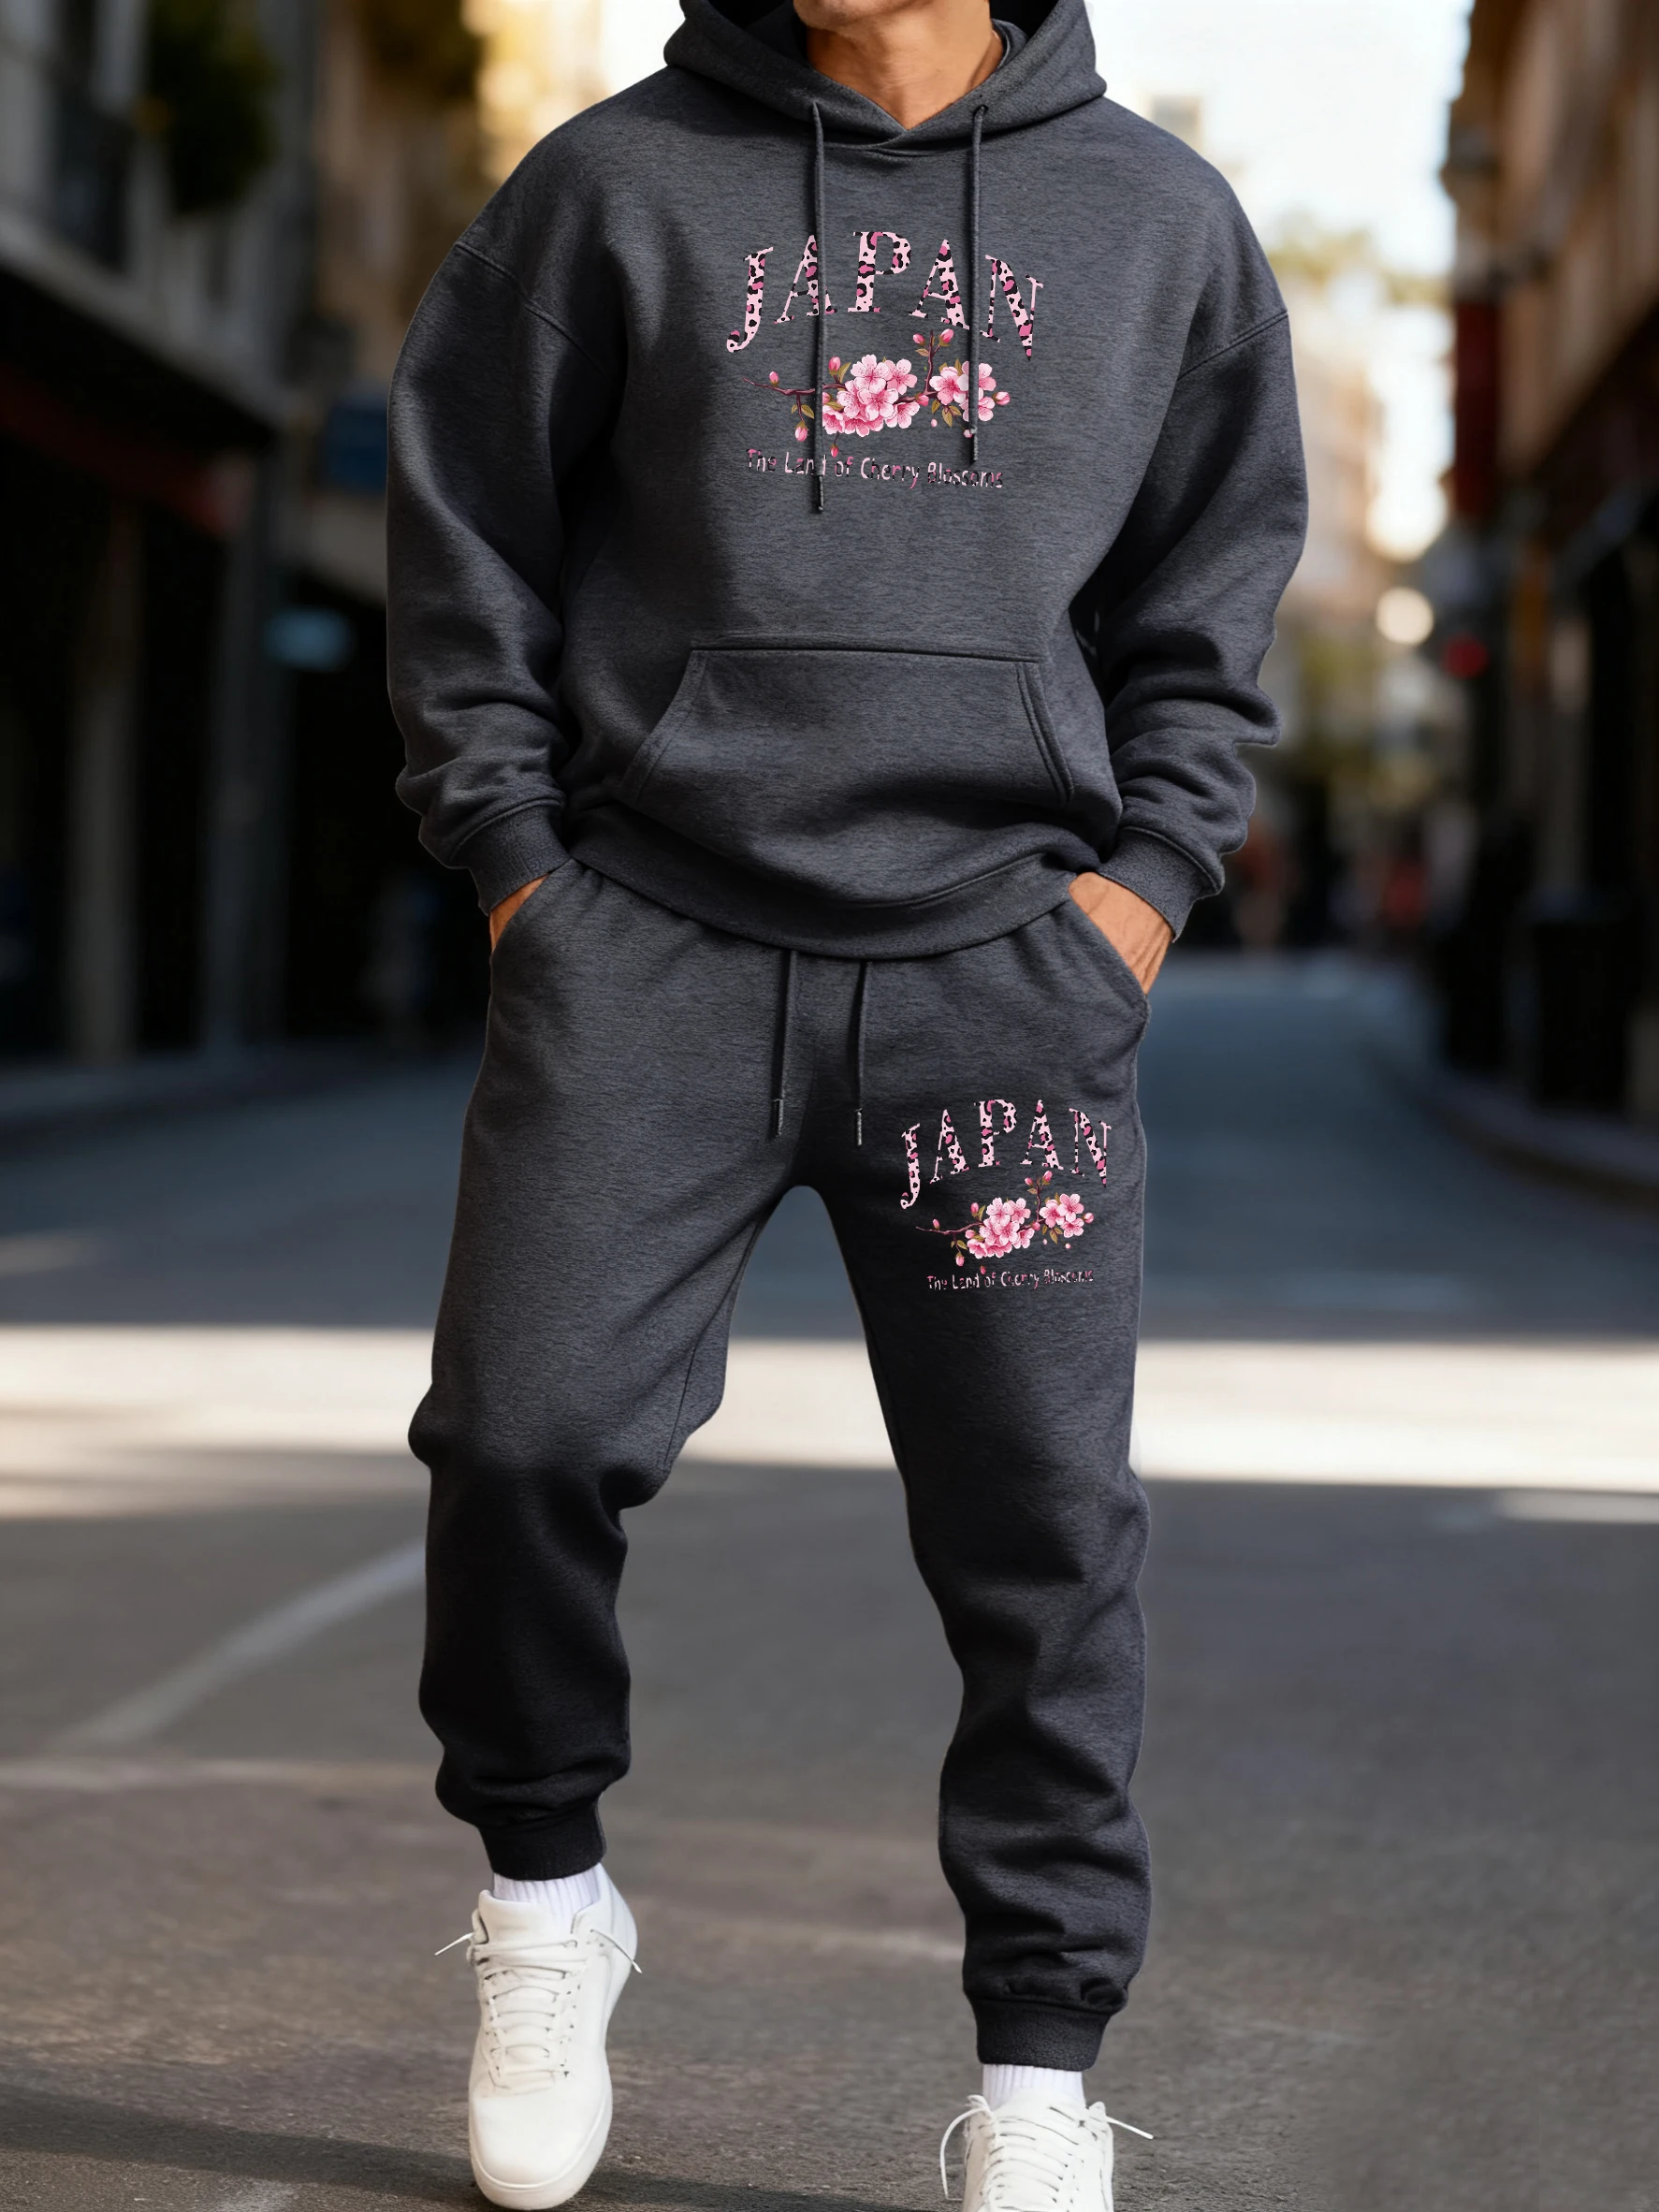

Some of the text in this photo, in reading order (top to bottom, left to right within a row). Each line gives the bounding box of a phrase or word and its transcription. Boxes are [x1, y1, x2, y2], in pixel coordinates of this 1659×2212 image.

[726, 231, 1044, 362] JAPAN
[746, 448, 778, 473] The
[834, 456, 854, 477] of
[860, 457, 921, 489] Cherry
[927, 461, 1004, 488] Blossoms
[900, 1099, 1113, 1210] JAPAN
[952, 1273, 981, 1289] Land
[983, 1272, 997, 1288] of
